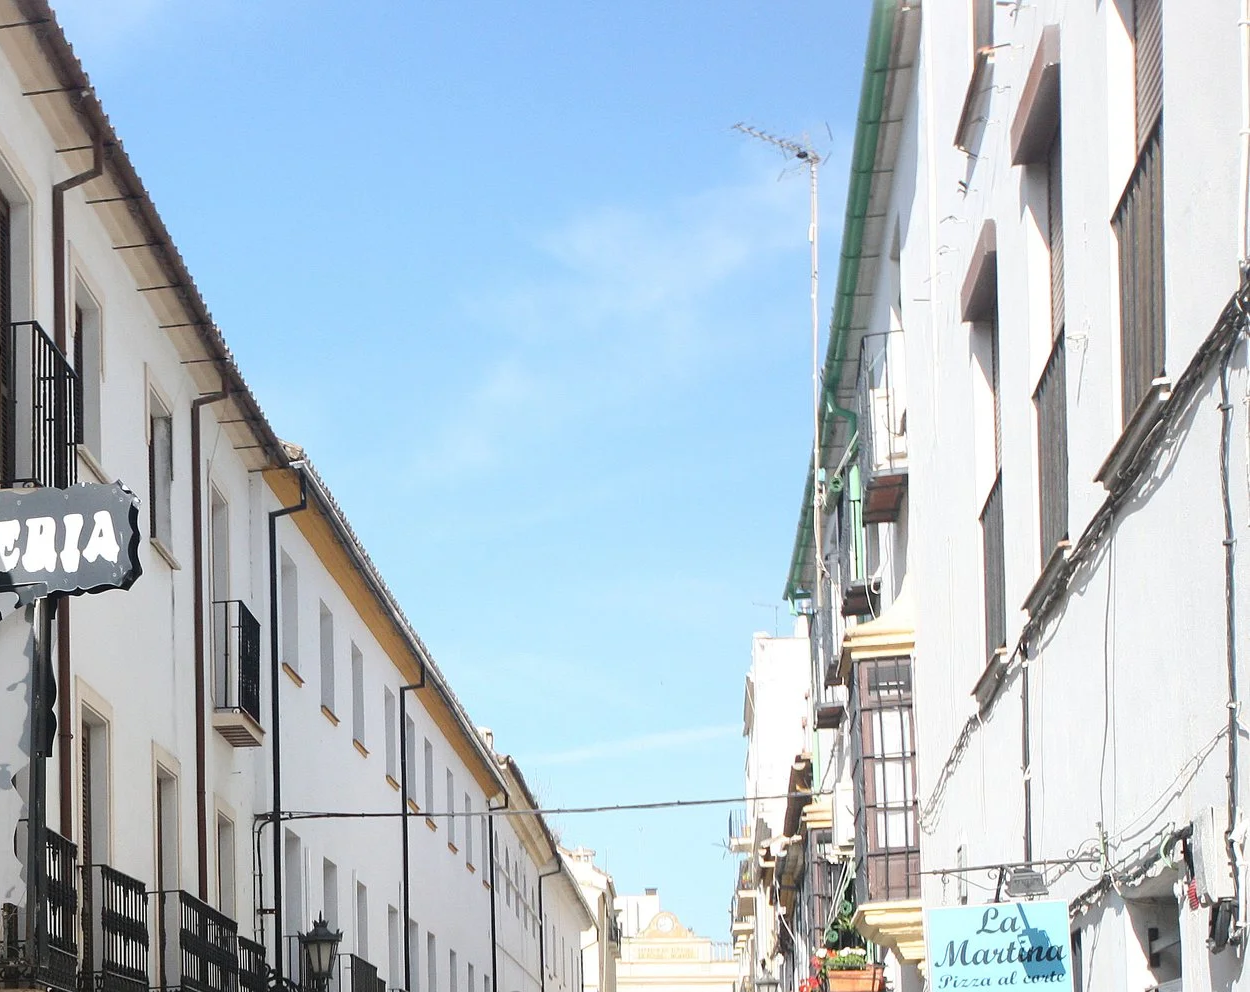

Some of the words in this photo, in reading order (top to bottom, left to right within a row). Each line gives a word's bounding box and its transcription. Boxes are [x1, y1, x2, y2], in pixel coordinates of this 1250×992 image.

[976, 906, 1021, 935] La
[934, 939, 1067, 968] Martina
[938, 973, 991, 989] Pizza
[998, 971, 1018, 986] al
[1023, 970, 1066, 985] corte
